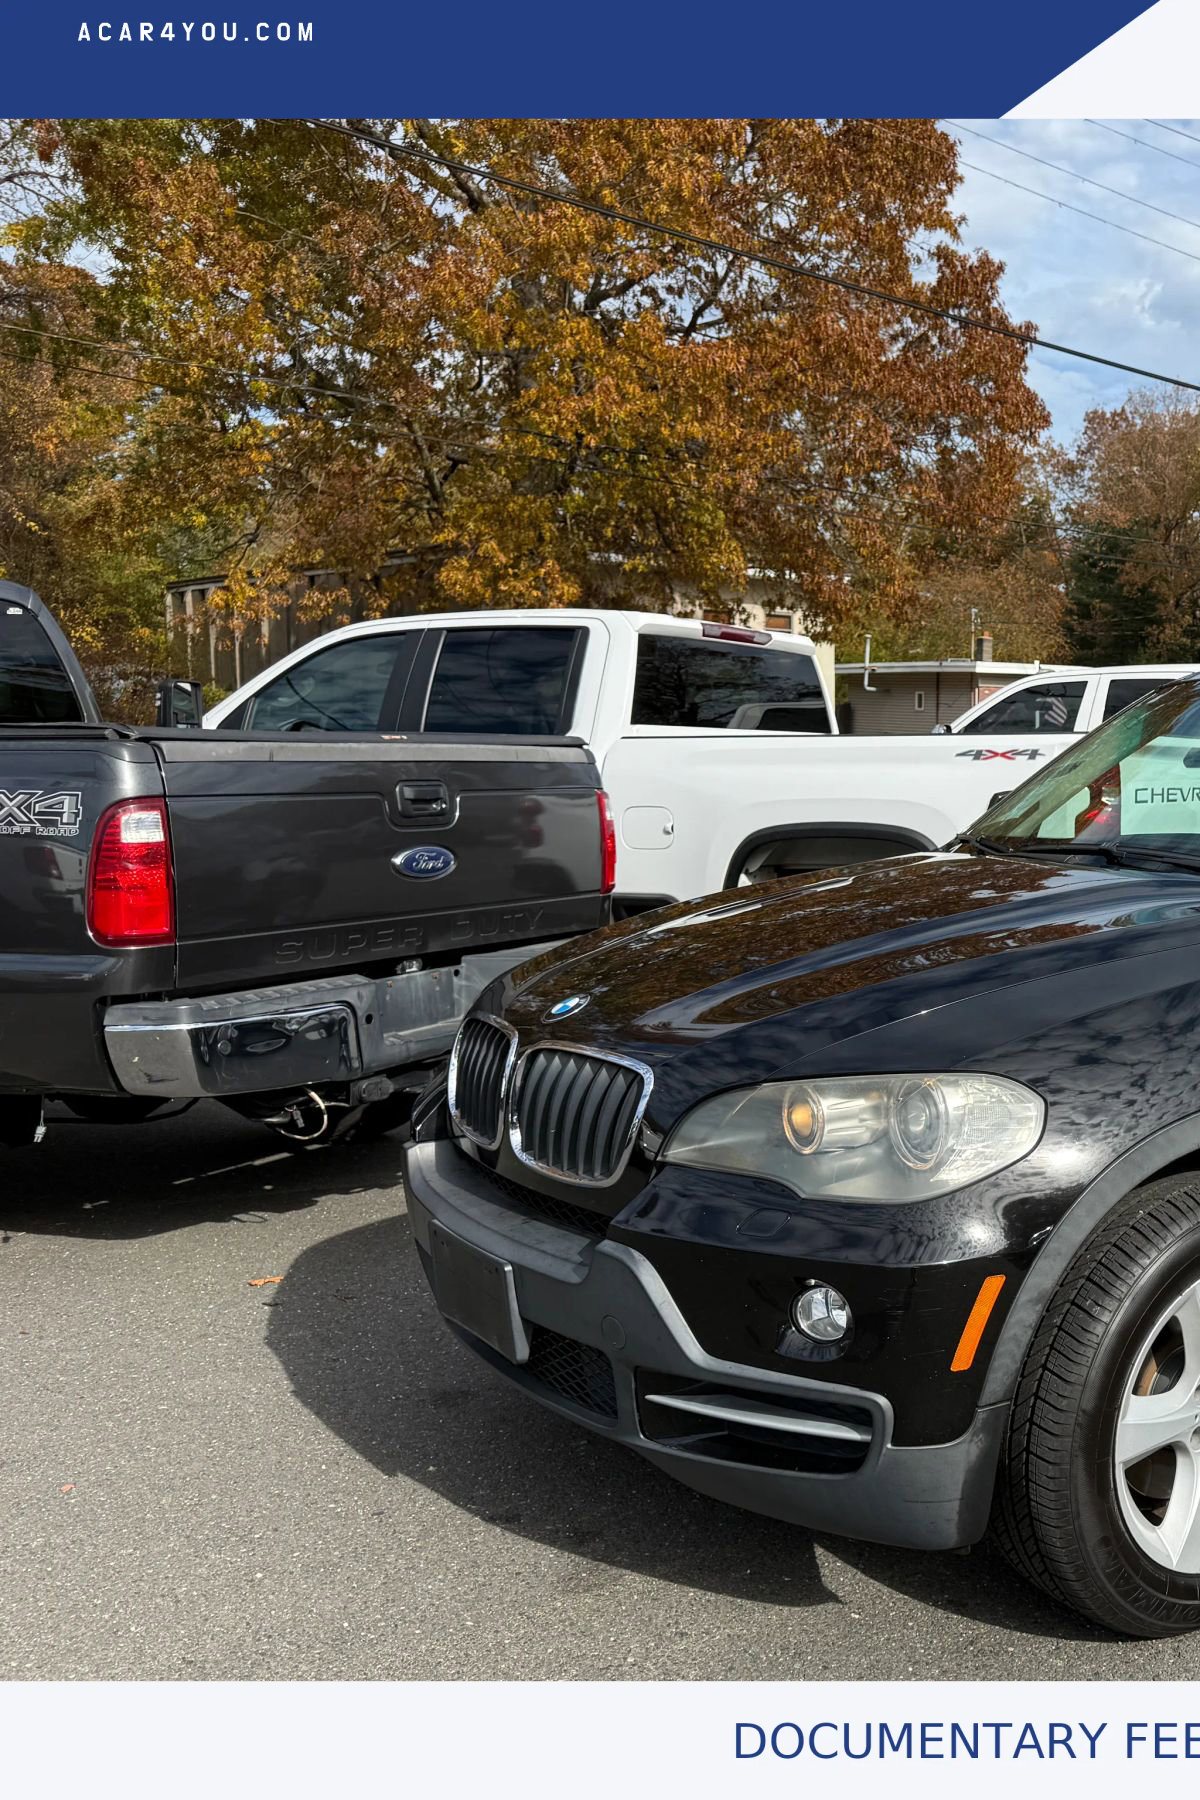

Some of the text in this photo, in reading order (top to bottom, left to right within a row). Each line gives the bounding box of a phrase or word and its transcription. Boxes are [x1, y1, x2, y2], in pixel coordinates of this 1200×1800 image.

[35, 826, 79, 837] ROAD
[412, 851, 445, 870] Ford
[275, 909, 544, 965] SUPER DUTY
